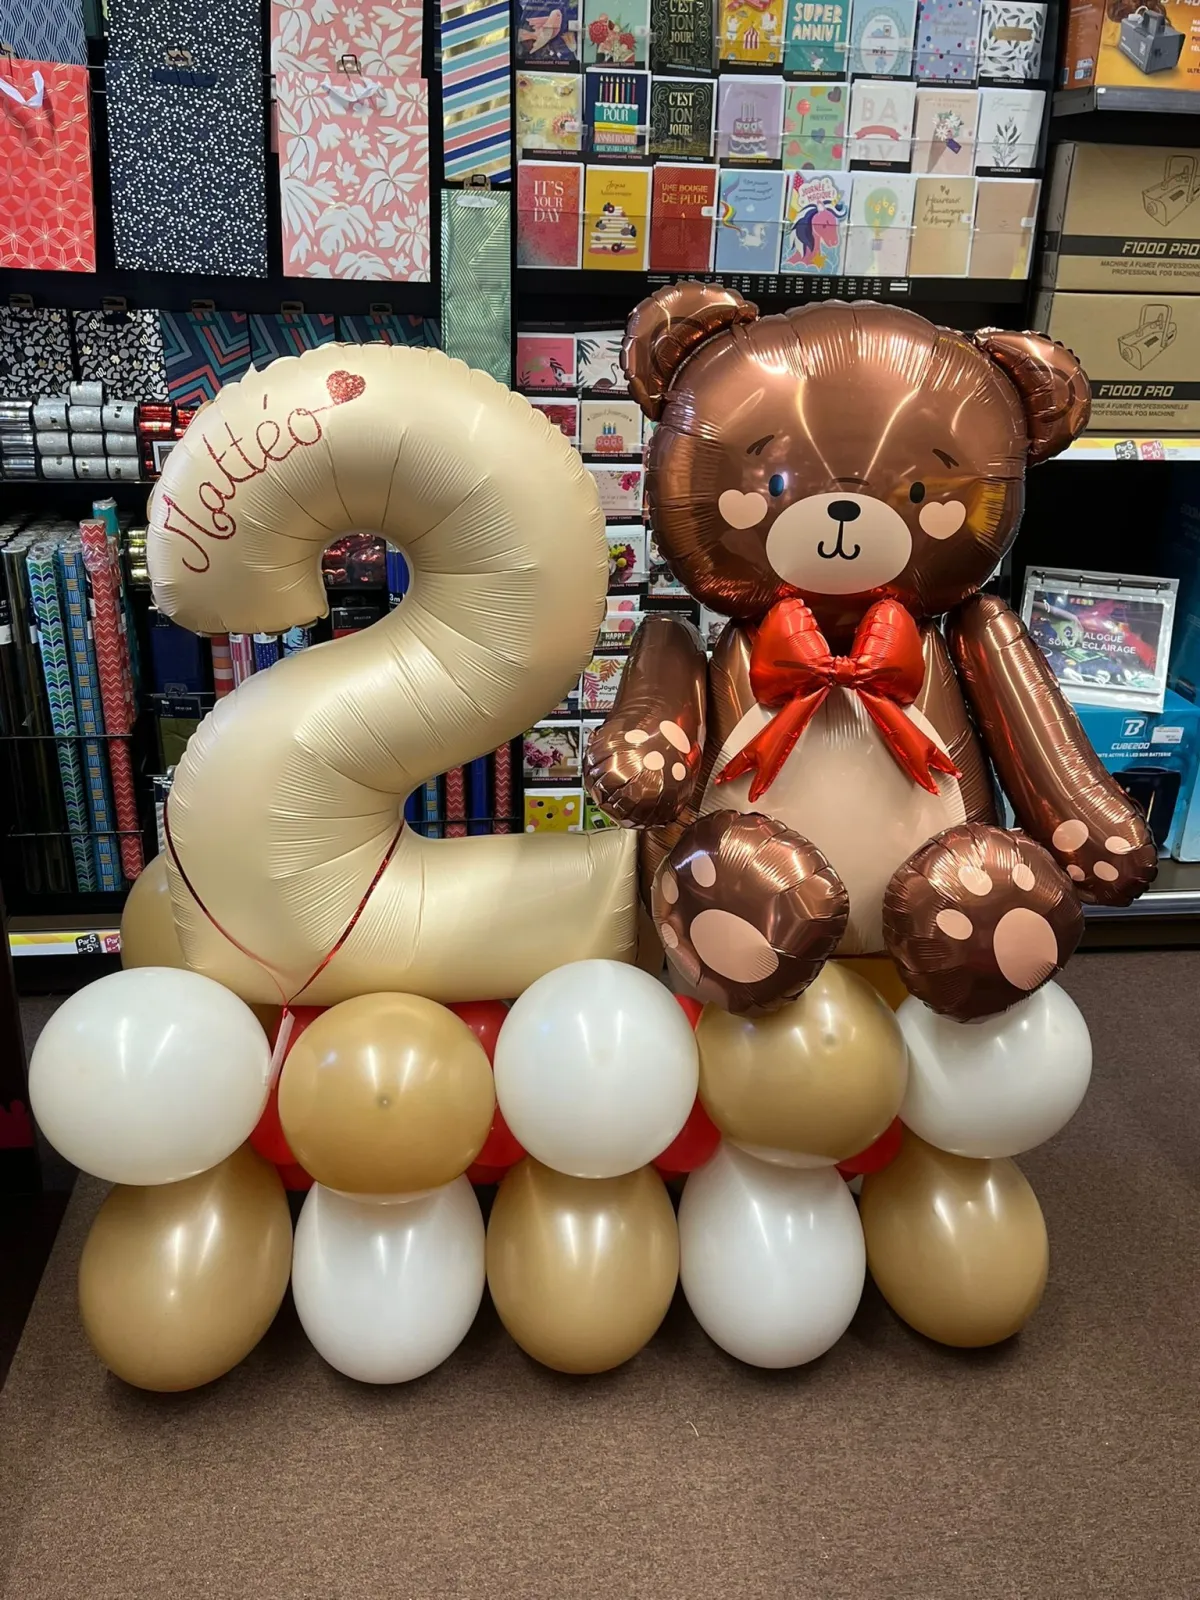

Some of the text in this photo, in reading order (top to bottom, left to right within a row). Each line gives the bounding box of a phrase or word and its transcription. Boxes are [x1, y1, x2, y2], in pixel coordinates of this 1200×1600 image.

[793, 3, 843, 24] SUPER
[671, 15, 693, 30] TON
[670, 31, 694, 43] JOUR!
[792, 24, 833, 42] ANNIV
[669, 91, 694, 107] C'EST
[603, 108, 628, 122] POUR
[669, 108, 693, 123] TON
[668, 124, 692, 136] JOUR!
[534, 180, 564, 196] IT'S
[662, 183, 708, 193] UNE BOUGIE
[534, 197, 563, 208] YOUR
[662, 193, 708, 205] DE PLUS
[534, 207, 561, 223] DAY
[1121, 241, 1200, 256] F1000 PRO
[1111, 268, 1158, 276] PROFESSIONAL
[1159, 269, 1172, 277] FOG
[1098, 384, 1175, 397] F1000 PRO
[1116, 445, 1127, 453] Par
[605, 632, 626, 640] HAPPY
[1081, 641, 1137, 655] ECLAIRAGE
[1124, 719, 1145, 736] B
[1111, 742, 1151, 750] CUBE200
[78, 934, 96, 946] Par 5
[106, 937, 117, 945] Par
